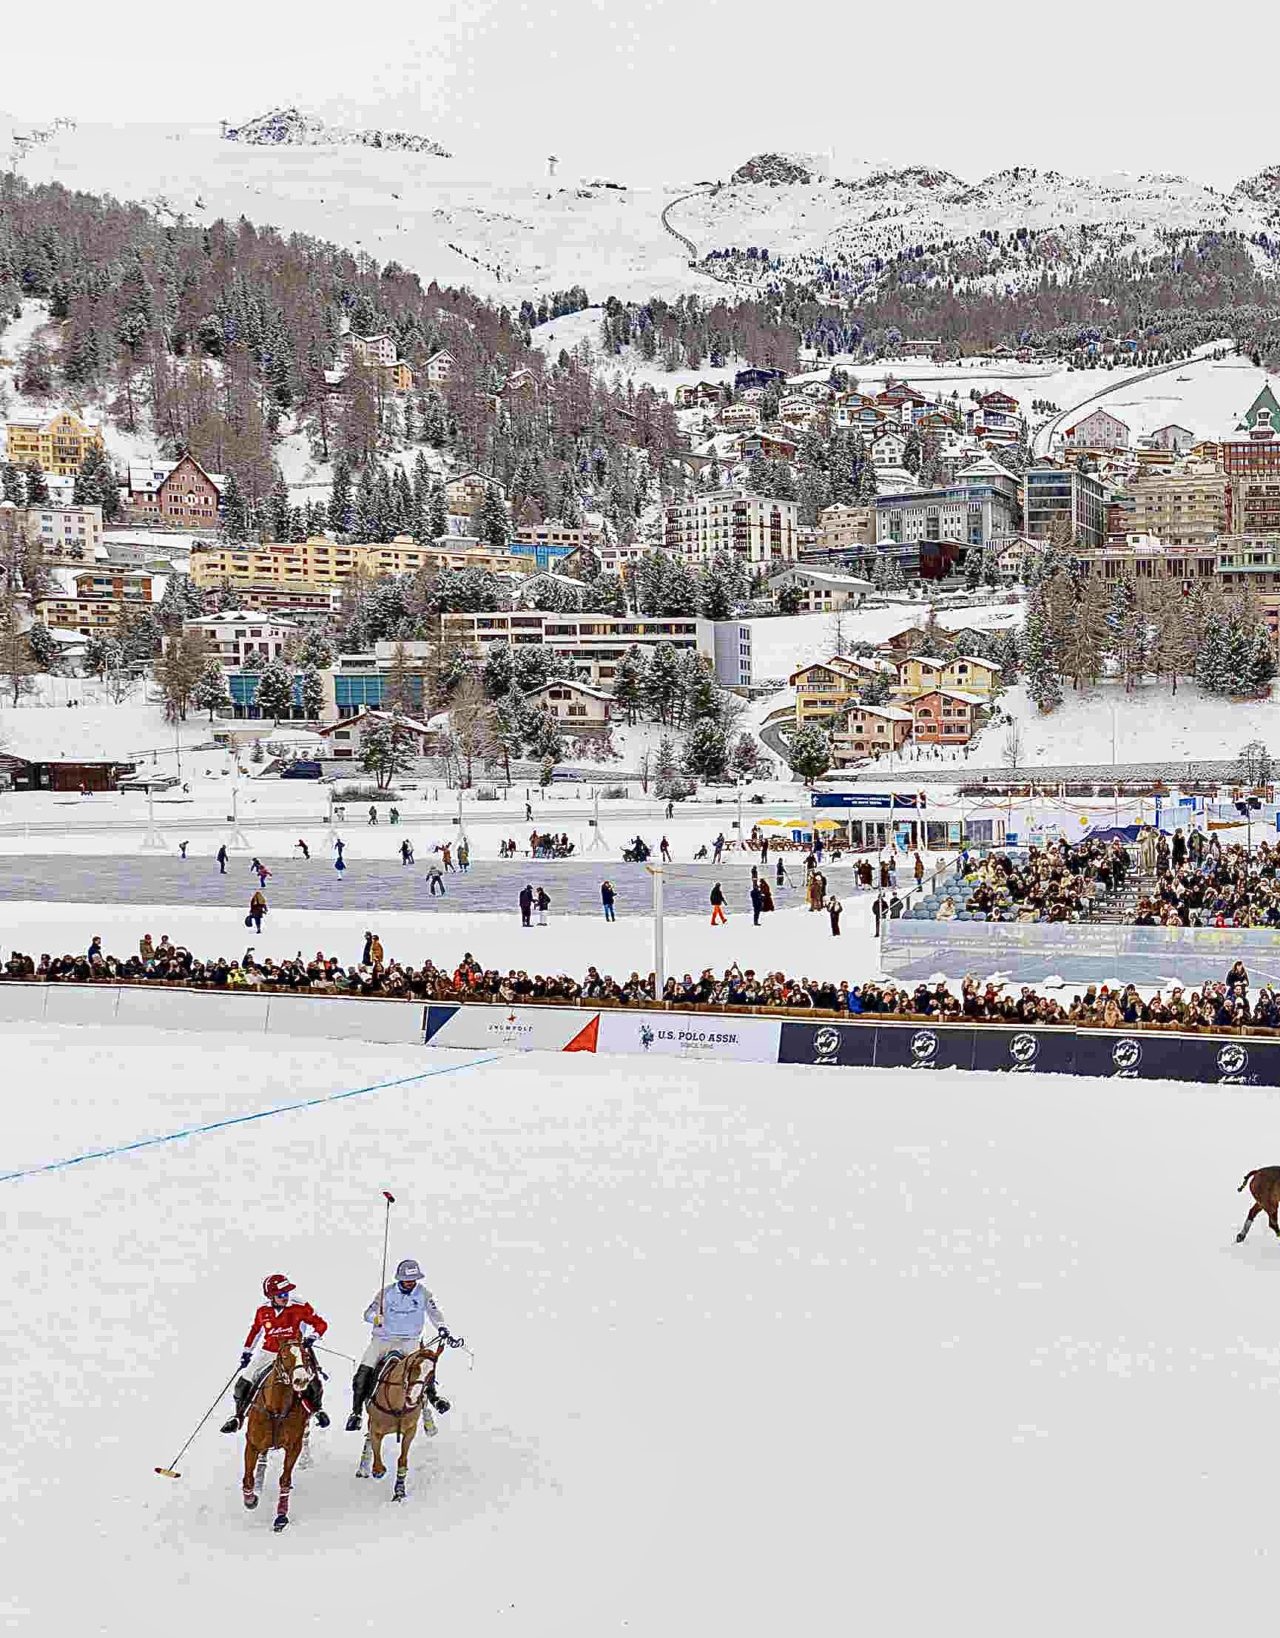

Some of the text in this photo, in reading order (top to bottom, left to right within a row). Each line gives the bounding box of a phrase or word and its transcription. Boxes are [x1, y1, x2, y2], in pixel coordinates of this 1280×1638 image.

[658, 1030, 739, 1044] U.S. POLO ASSN.
